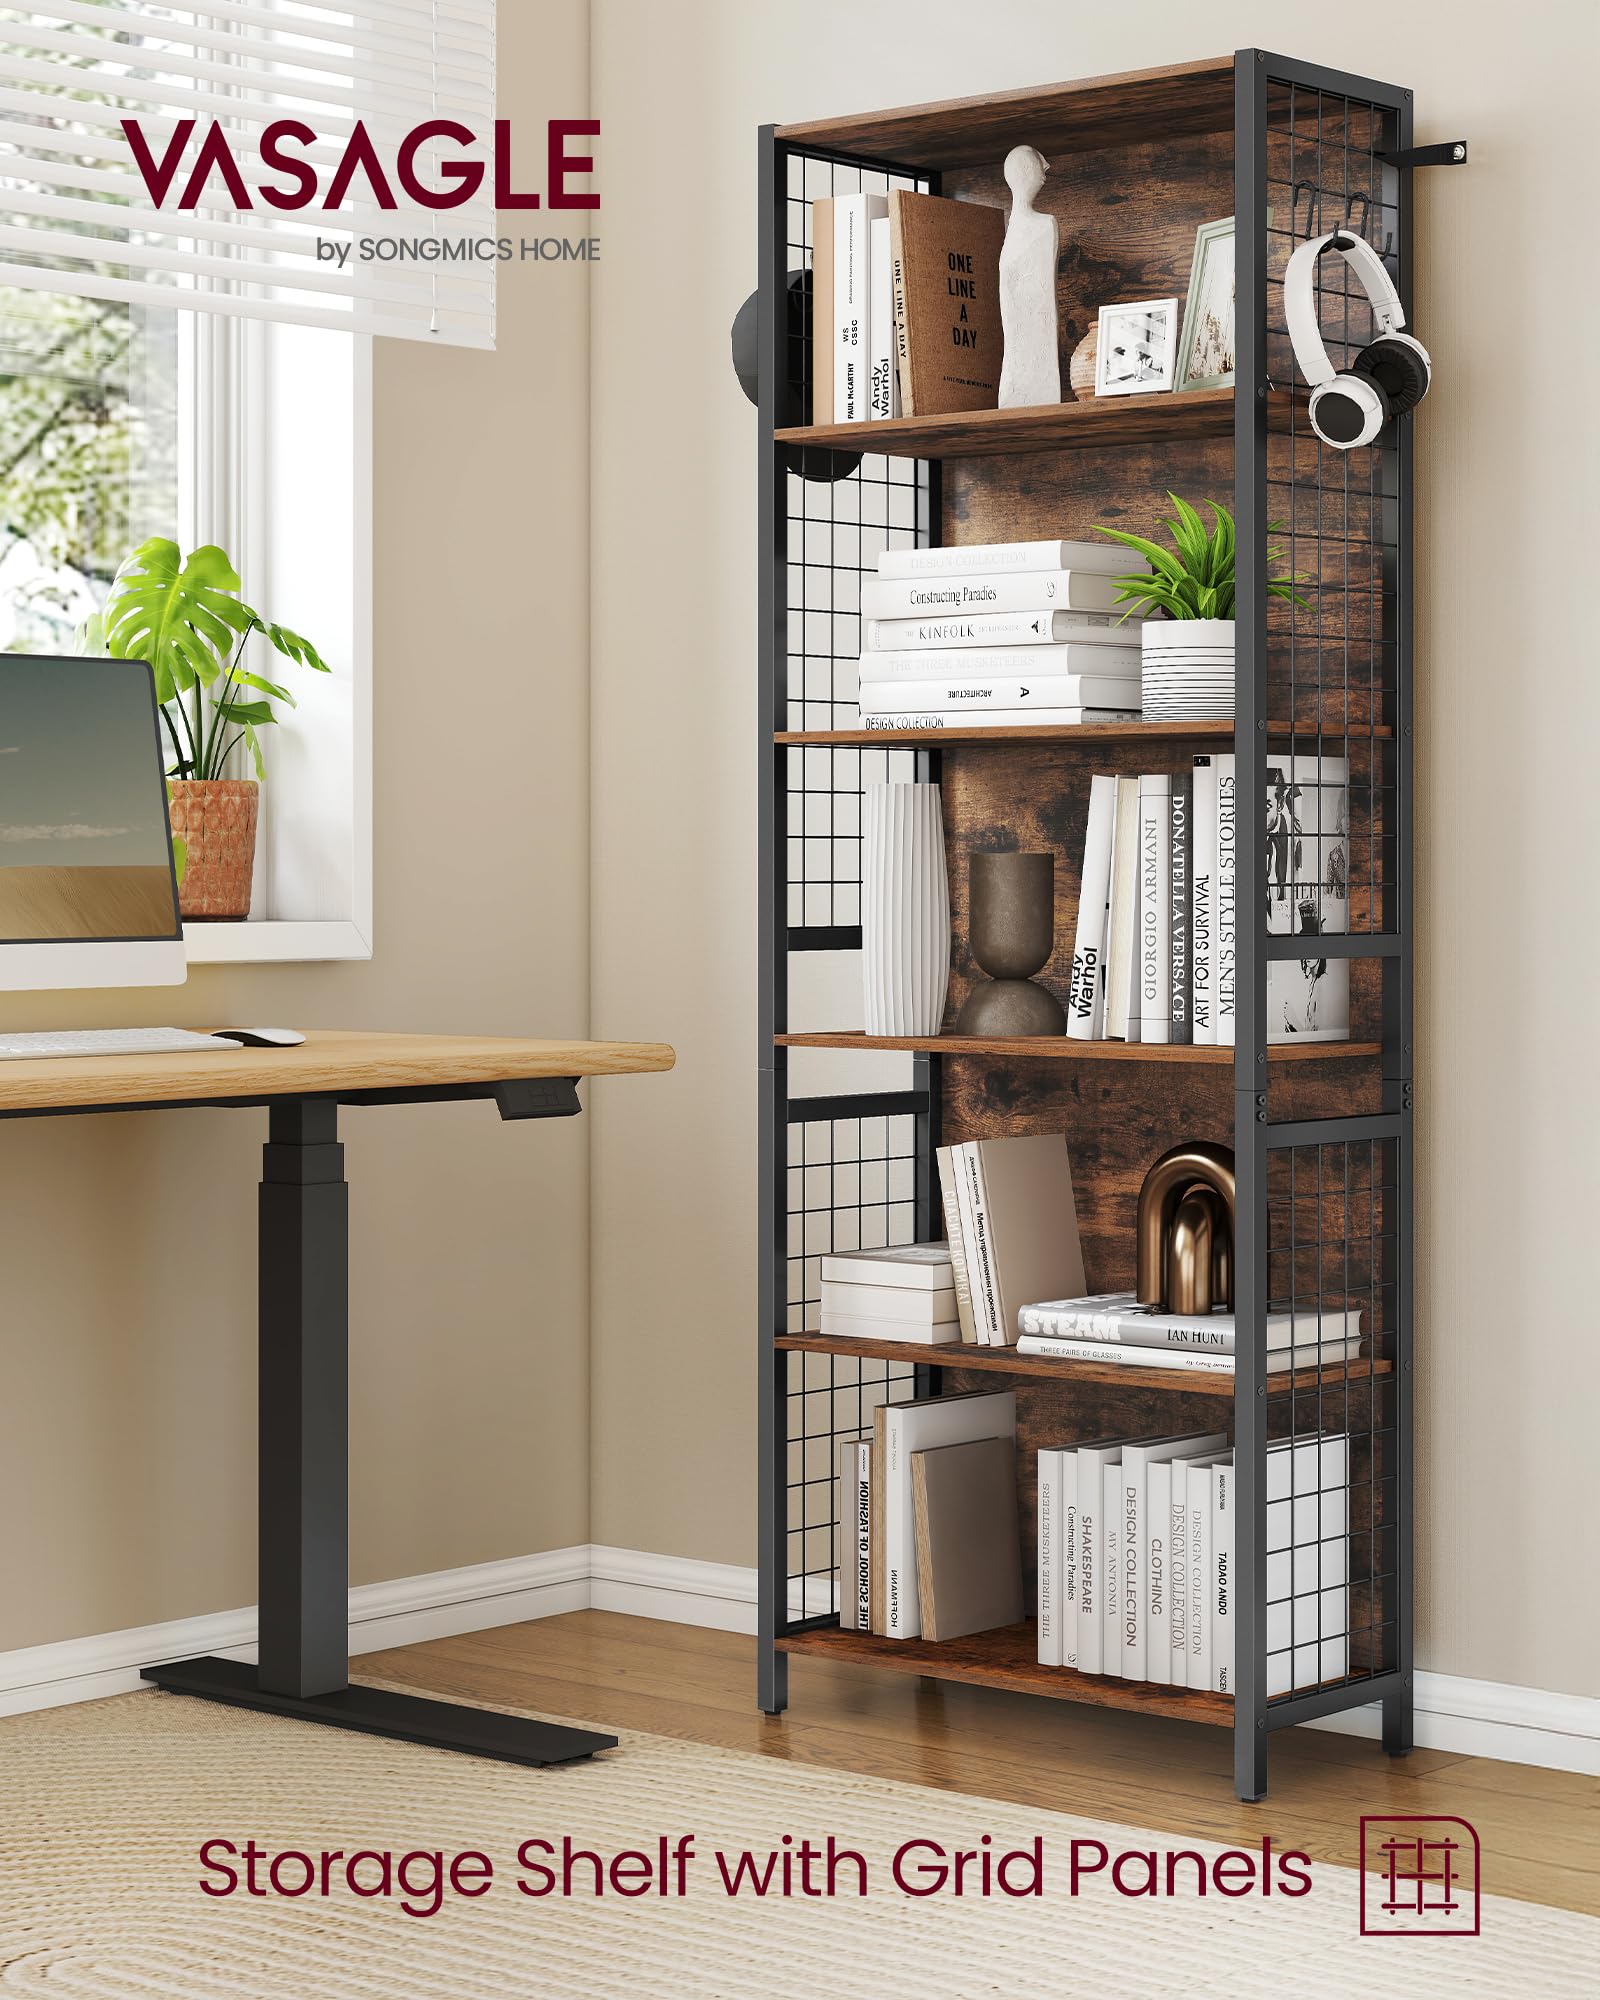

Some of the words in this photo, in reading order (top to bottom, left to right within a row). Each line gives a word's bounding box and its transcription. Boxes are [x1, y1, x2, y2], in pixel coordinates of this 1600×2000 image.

[948, 253, 974, 274] ONE
[896, 290, 904, 317] LINE
[949, 277, 977, 299] LINE
[843, 327, 849, 342] WS
[898, 323, 905, 331] A
[960, 304, 968, 322] A
[899, 335, 907, 358] DAY
[952, 328, 977, 349] DAY
[871, 366, 882, 409] Andy
[881, 358, 889, 416] Warhol
[910, 587, 960, 605] Constructing
[963, 585, 997, 602] Paradies
[919, 624, 975, 640] KINFOLK
[948, 689, 992, 699] ARCHITECTURE
[865, 717, 894, 730] DESIGN
[896, 716, 944, 730] COLLECTION
[1219, 776, 1235, 868] STORIES
[1145, 818, 1157, 903] ARMANI
[1172, 795, 1185, 922] DONATELLA
[1195, 875, 1209, 950] SURVIVAL
[1219, 874, 1235, 942] STYLE
[1145, 911, 1157, 1000] GIORGIO
[1172, 926, 1185, 1022] VERSACE
[1195, 957, 1209, 989] FOR
[1068, 953, 1084, 1007] Andy
[1077, 947, 1098, 1018] Warhol
[1219, 949, 1235, 1016] MEN'S
[1195, 997, 1209, 1028] ART
[944, 1190, 962, 1248] СПАСИТЕ
[1024, 1309, 1122, 1341] STEAM
[1167, 1328, 1188, 1342] IAN
[1040, 1346, 1060, 1355] THREE
[1062, 1347, 1080, 1356] PAIRS
[1082, 1349, 1092, 1358] OF
[1092, 1350, 1122, 1360] GLASSES
[1067, 1505, 1077, 1562] Constructing
[1126, 1487, 1137, 1544] DESIGN
[1172, 1504, 1185, 1557] DESIGN
[1192, 1511, 1202, 1563] DESIGN
[1082, 1516, 1092, 1613] SHAKESPEARE
[1108, 1531, 1117, 1551] MY
[1067, 1564, 1077, 1600] Paradies
[1108, 1555, 1117, 1615] ANTONIA
[1152, 1538, 1162, 1615] CLOTHING
[1218, 1551, 1227, 1585] TADAO
[1126, 1549, 1137, 1646] COLLECTION
[1172, 1561, 1185, 1650] COLLECTION
[1192, 1567, 1202, 1656] COLLECTION
[1218, 1587, 1228, 1615] ANDO
